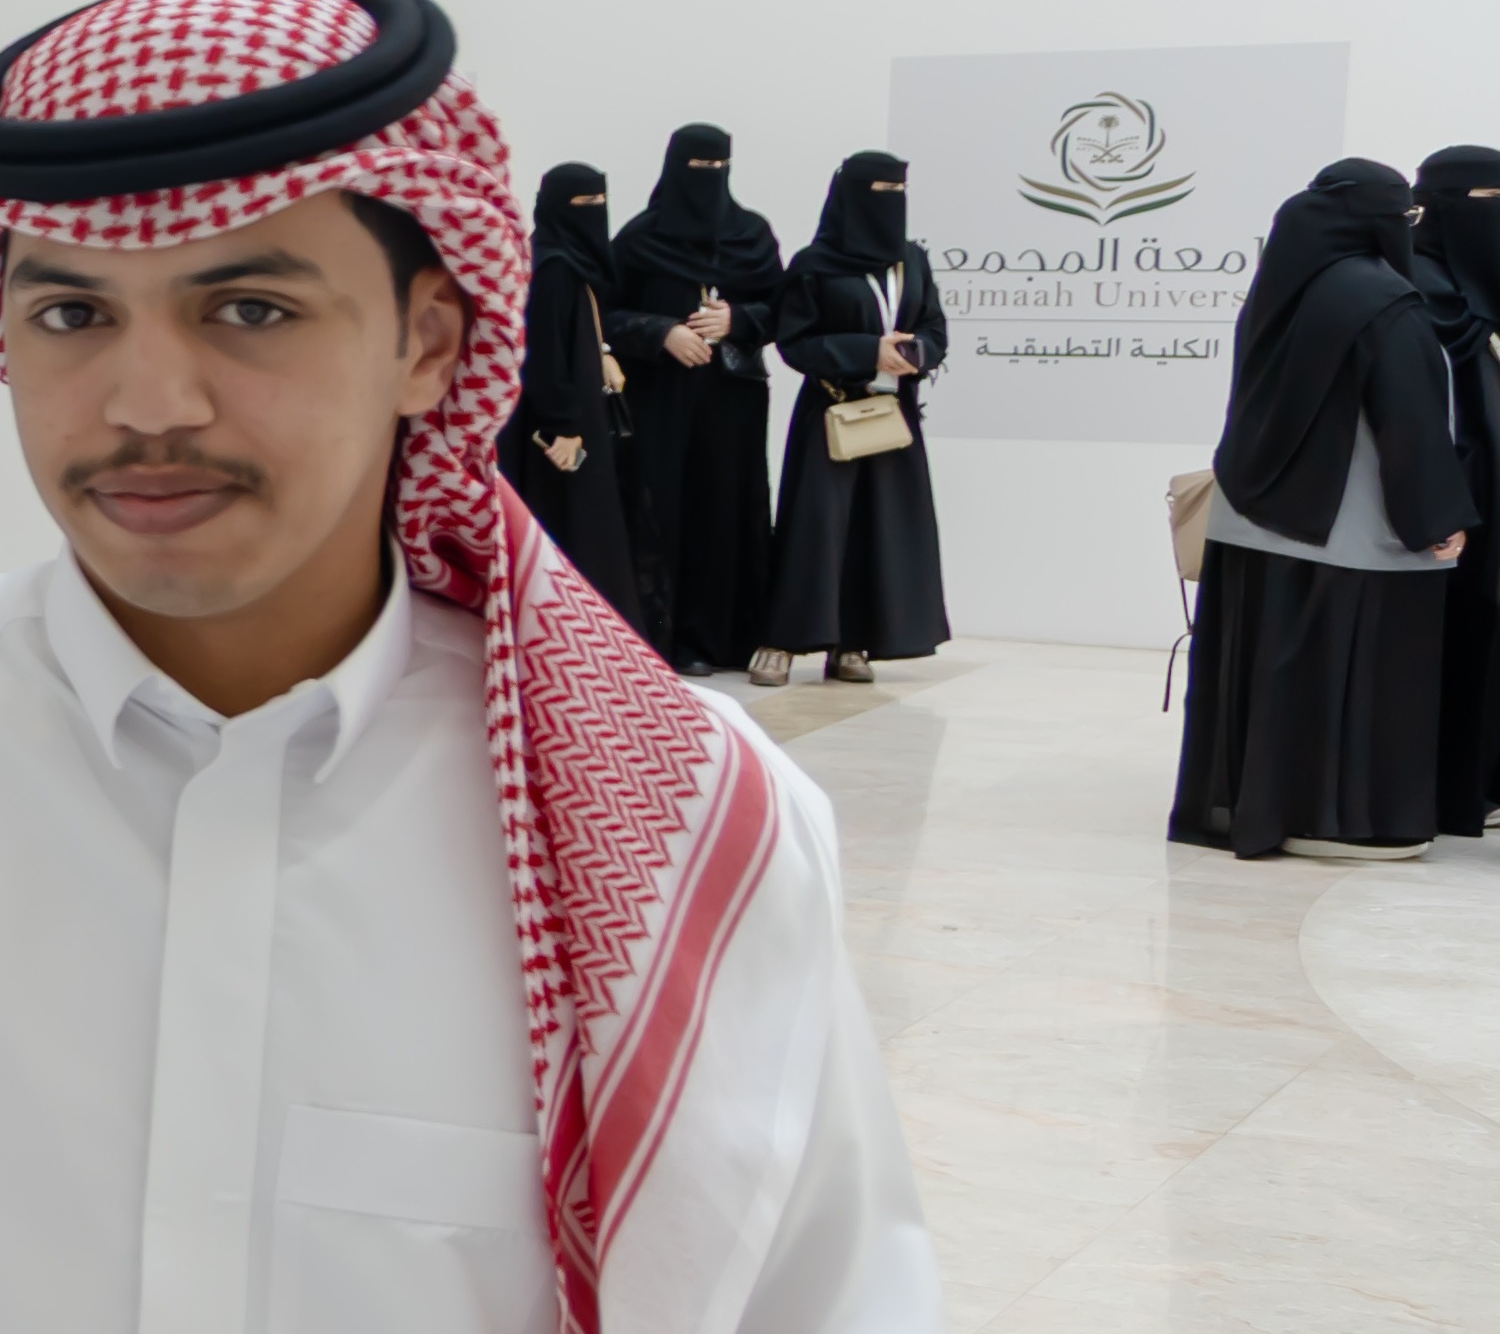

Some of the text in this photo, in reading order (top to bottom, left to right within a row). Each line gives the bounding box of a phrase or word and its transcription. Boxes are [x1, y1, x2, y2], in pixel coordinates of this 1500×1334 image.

[920, 237, 1265, 281] امعة المجمع
[939, 280, 1247, 316] ajmaah Univers
[975, 336, 1220, 366] الكلية التطبيقية
